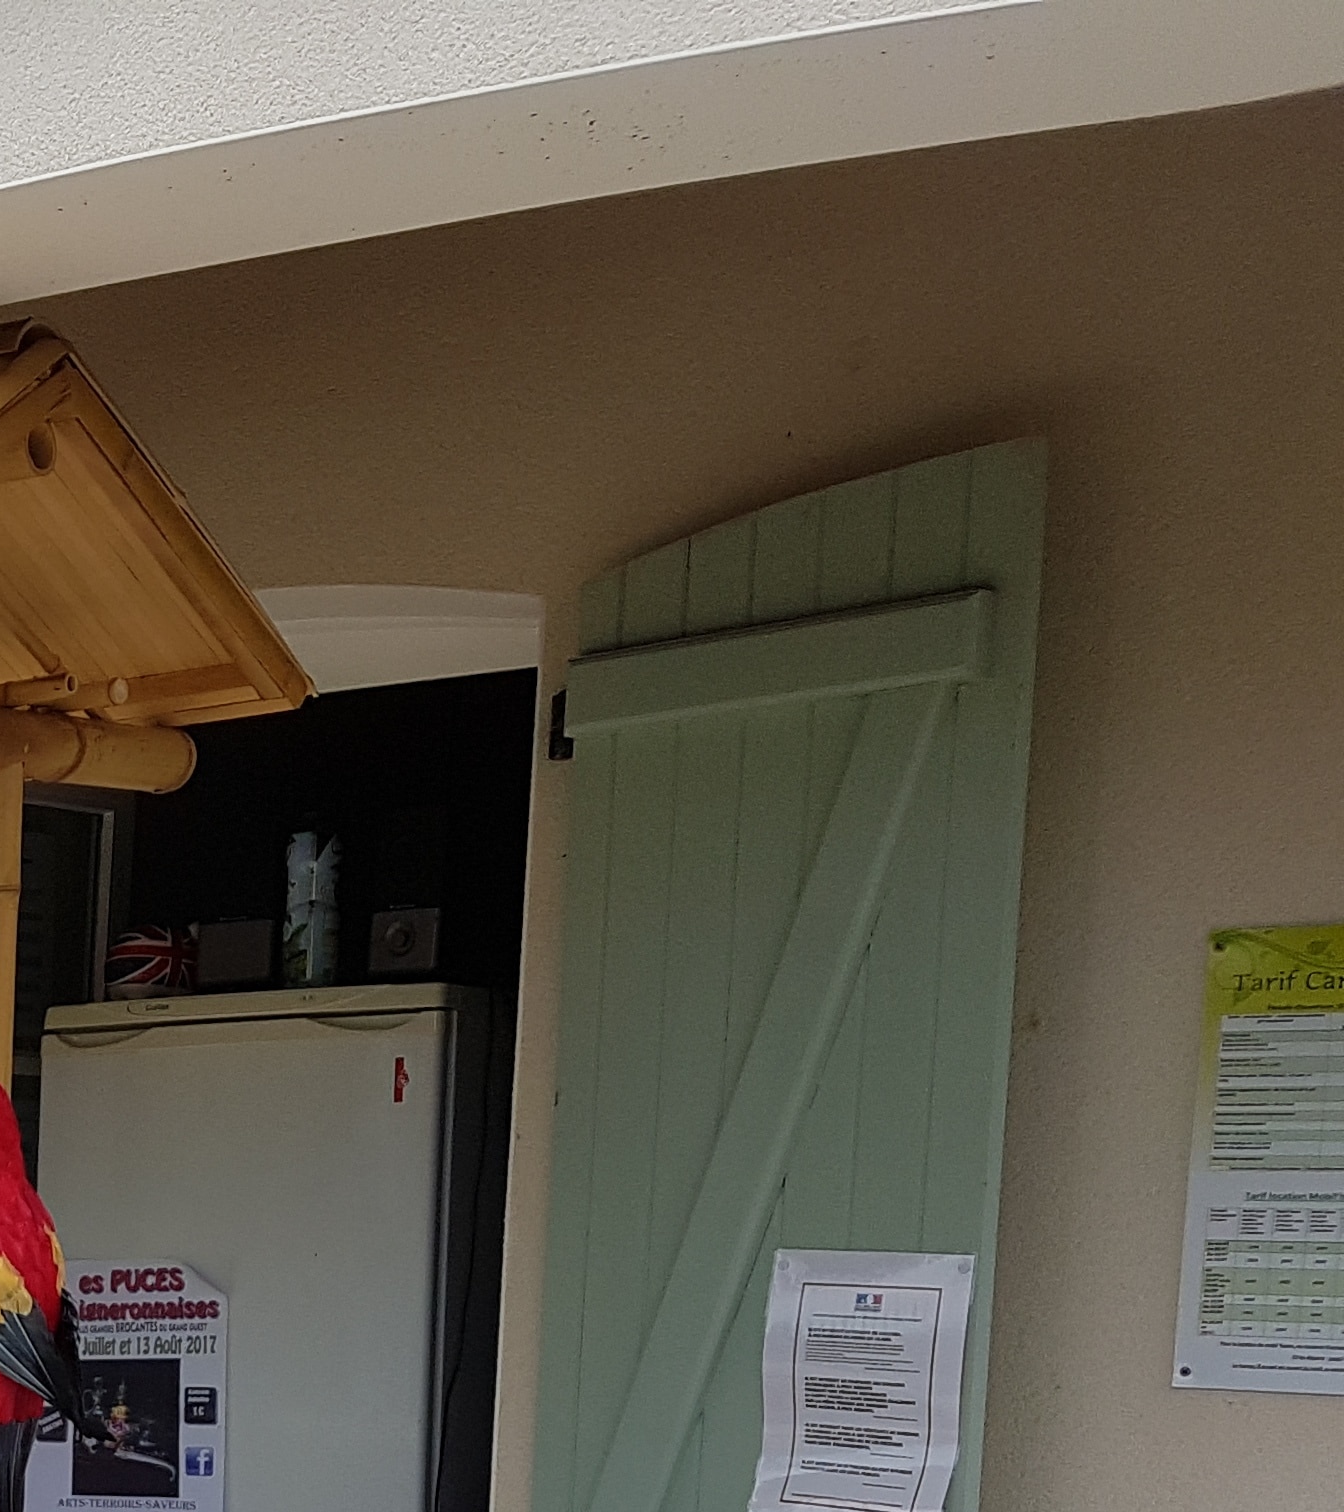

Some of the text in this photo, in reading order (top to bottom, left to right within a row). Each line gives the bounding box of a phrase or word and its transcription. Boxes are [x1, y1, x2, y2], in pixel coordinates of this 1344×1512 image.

[1233, 969, 1300, 992] Tarif
[78, 1266, 186, 1295] es PUCES
[79, 1296, 220, 1322] igneronnaises
[115, 1321, 158, 1333] BROCANTES
[81, 1334, 217, 1356] Juillet et 13 Août 2017
